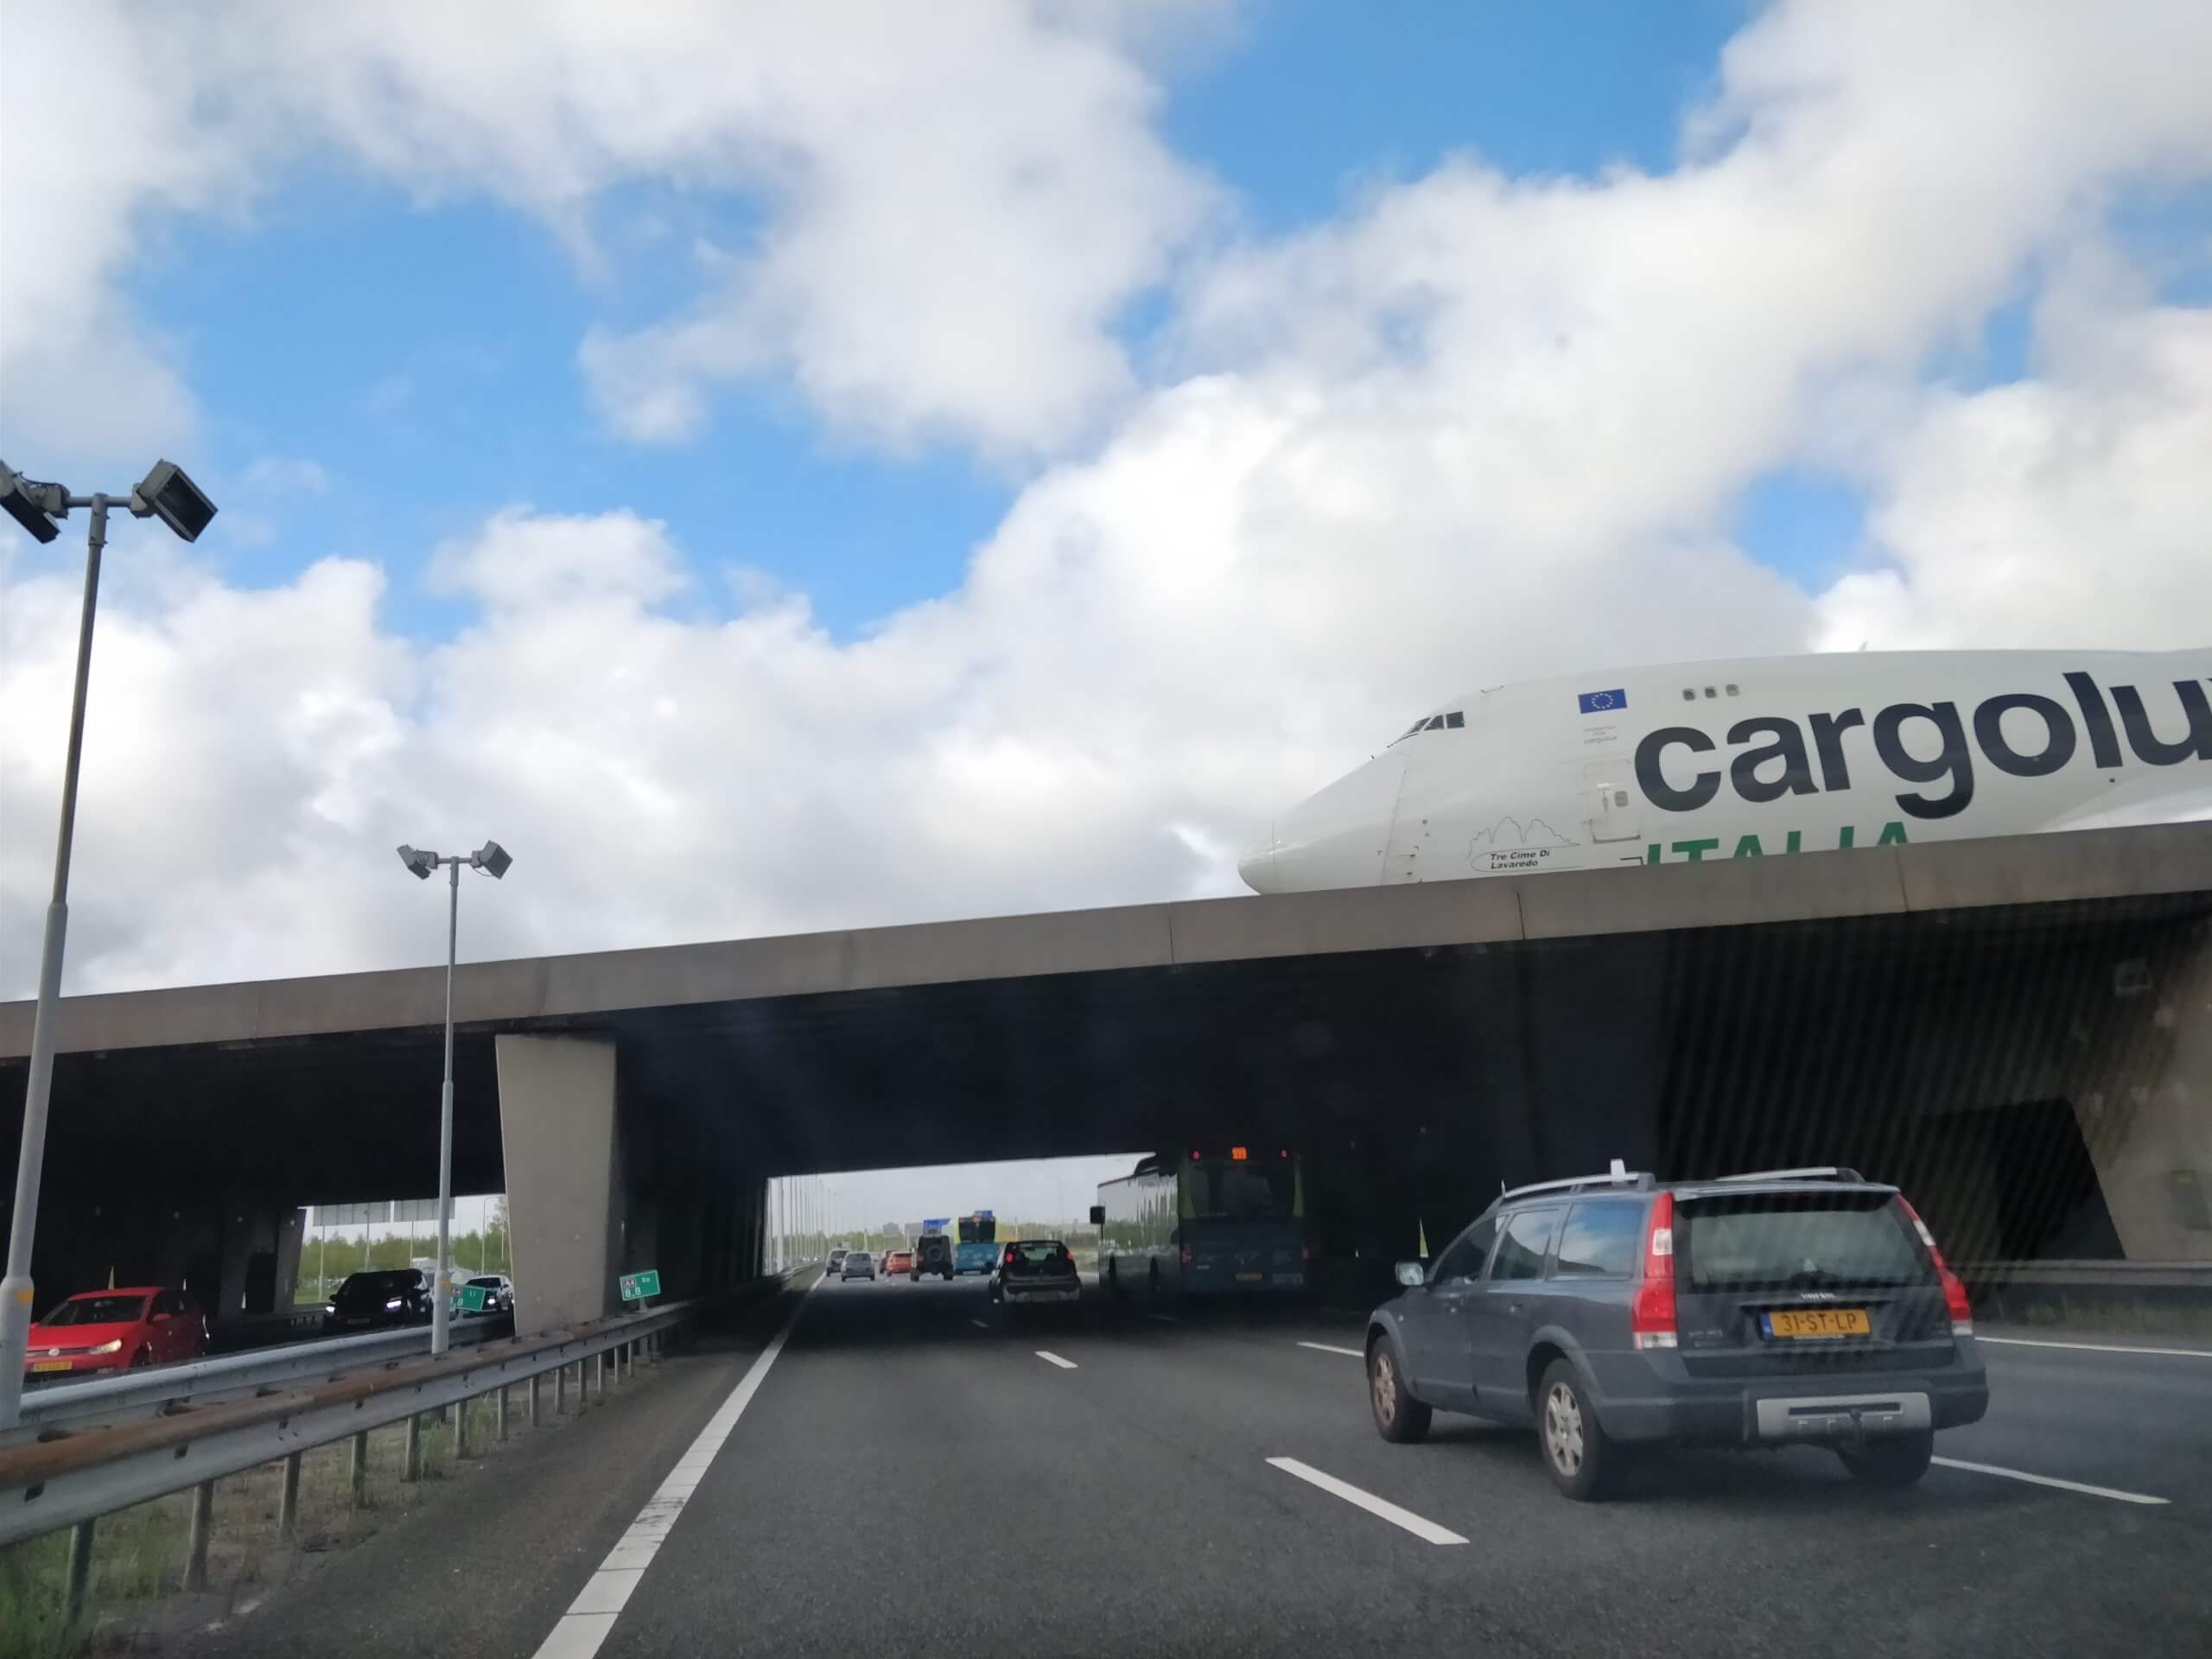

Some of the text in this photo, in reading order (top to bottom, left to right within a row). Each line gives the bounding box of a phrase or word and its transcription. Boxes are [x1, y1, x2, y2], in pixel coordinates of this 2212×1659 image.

[1634, 671, 2212, 820] cargolu
[1491, 853, 1507, 861] Tre
[1510, 851, 1536, 860] Cime
[1491, 859, 1539, 869] Lavaredo
[1780, 1313, 1857, 1332] 31-ST-LP
